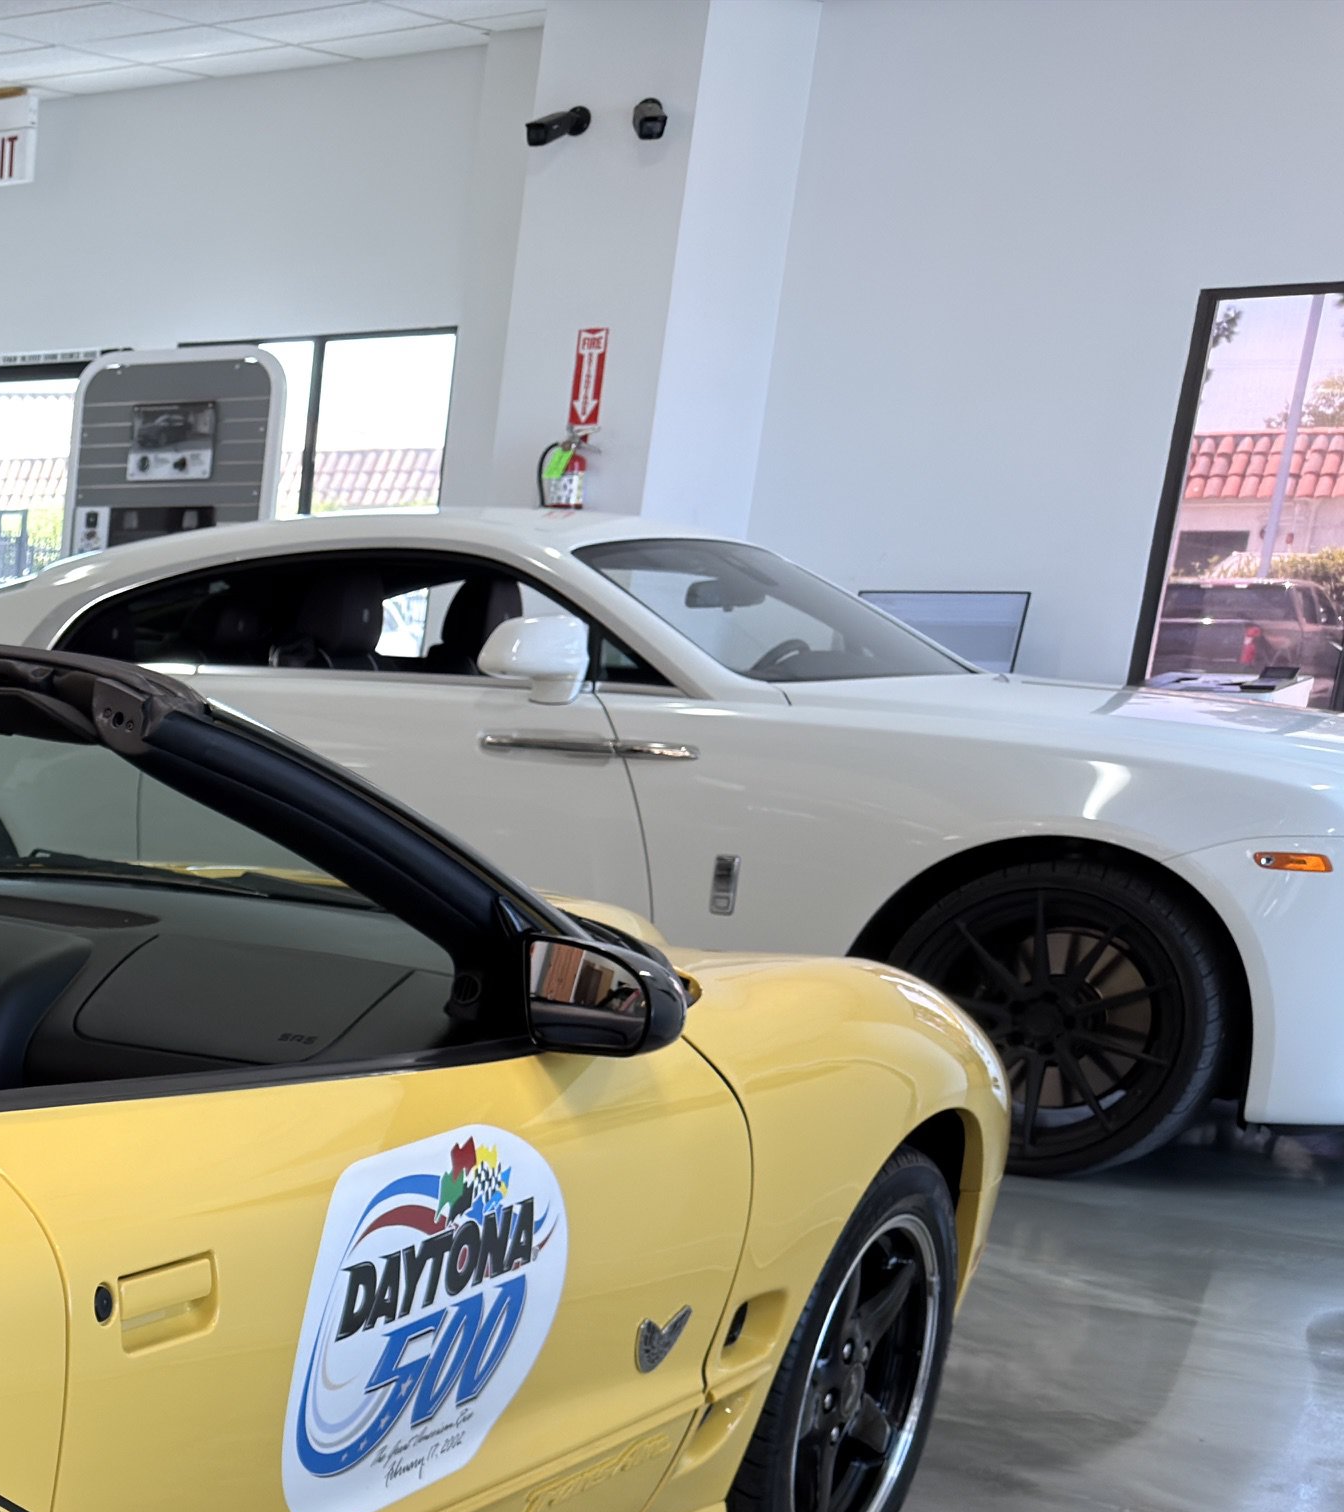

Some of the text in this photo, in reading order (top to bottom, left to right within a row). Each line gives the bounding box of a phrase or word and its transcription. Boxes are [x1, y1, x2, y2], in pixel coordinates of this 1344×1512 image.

[581, 336, 604, 351] FIRE
[334, 1196, 536, 1343] DAYTONA
[364, 1273, 529, 1428] 500
